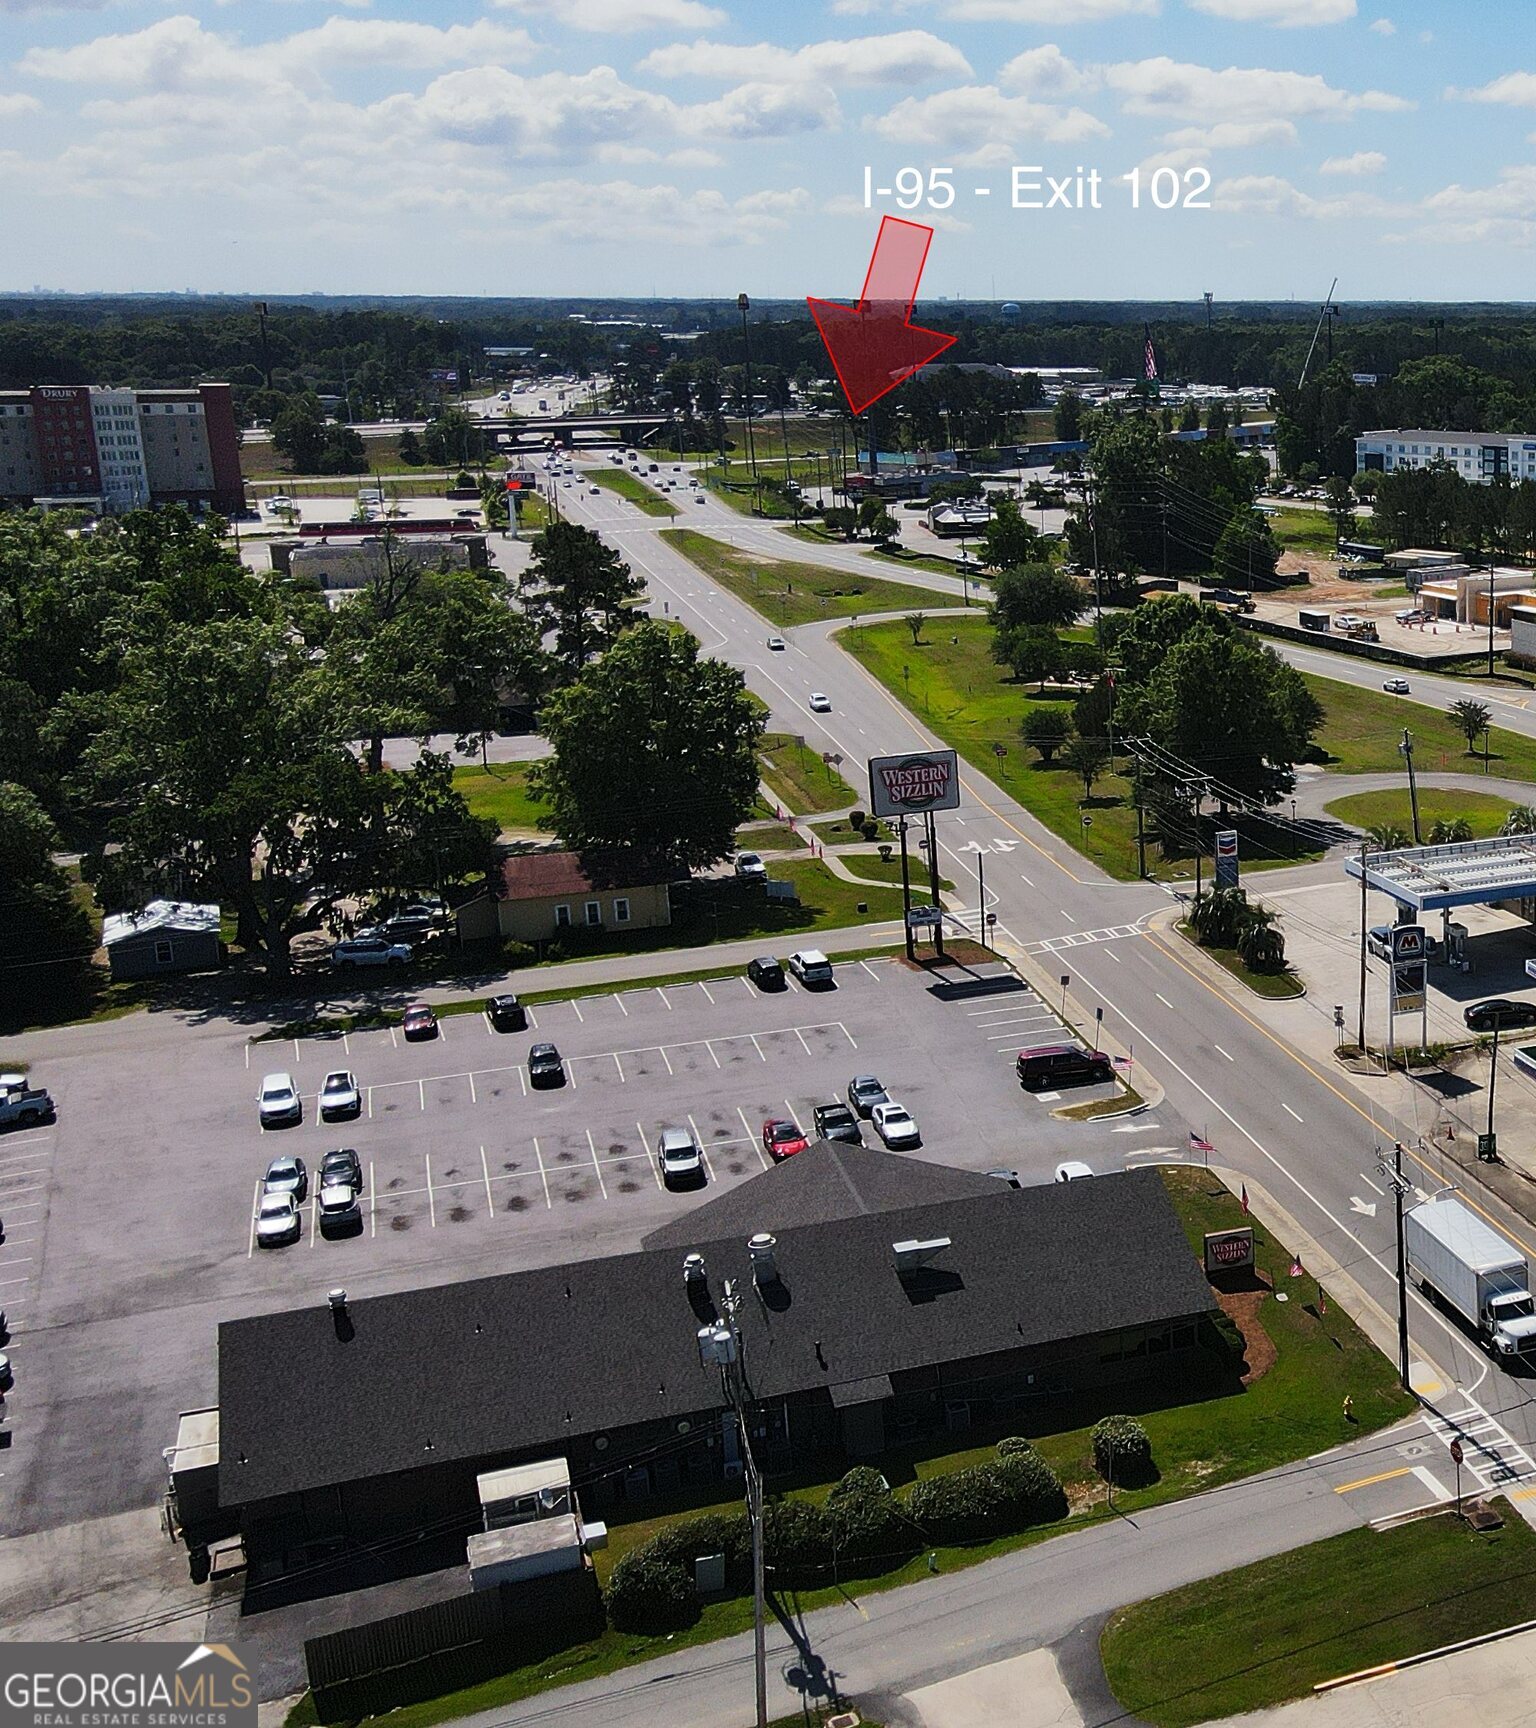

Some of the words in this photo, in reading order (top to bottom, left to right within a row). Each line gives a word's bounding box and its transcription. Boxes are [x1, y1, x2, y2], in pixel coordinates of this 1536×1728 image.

[41, 388, 78, 398] DRURY
[881, 763, 949, 786] WESTERN
[891, 780, 945, 802] SIZZLIN
[1211, 1239, 1250, 1254] WESTERN
[1216, 1249, 1247, 1261] SIZZLIN
